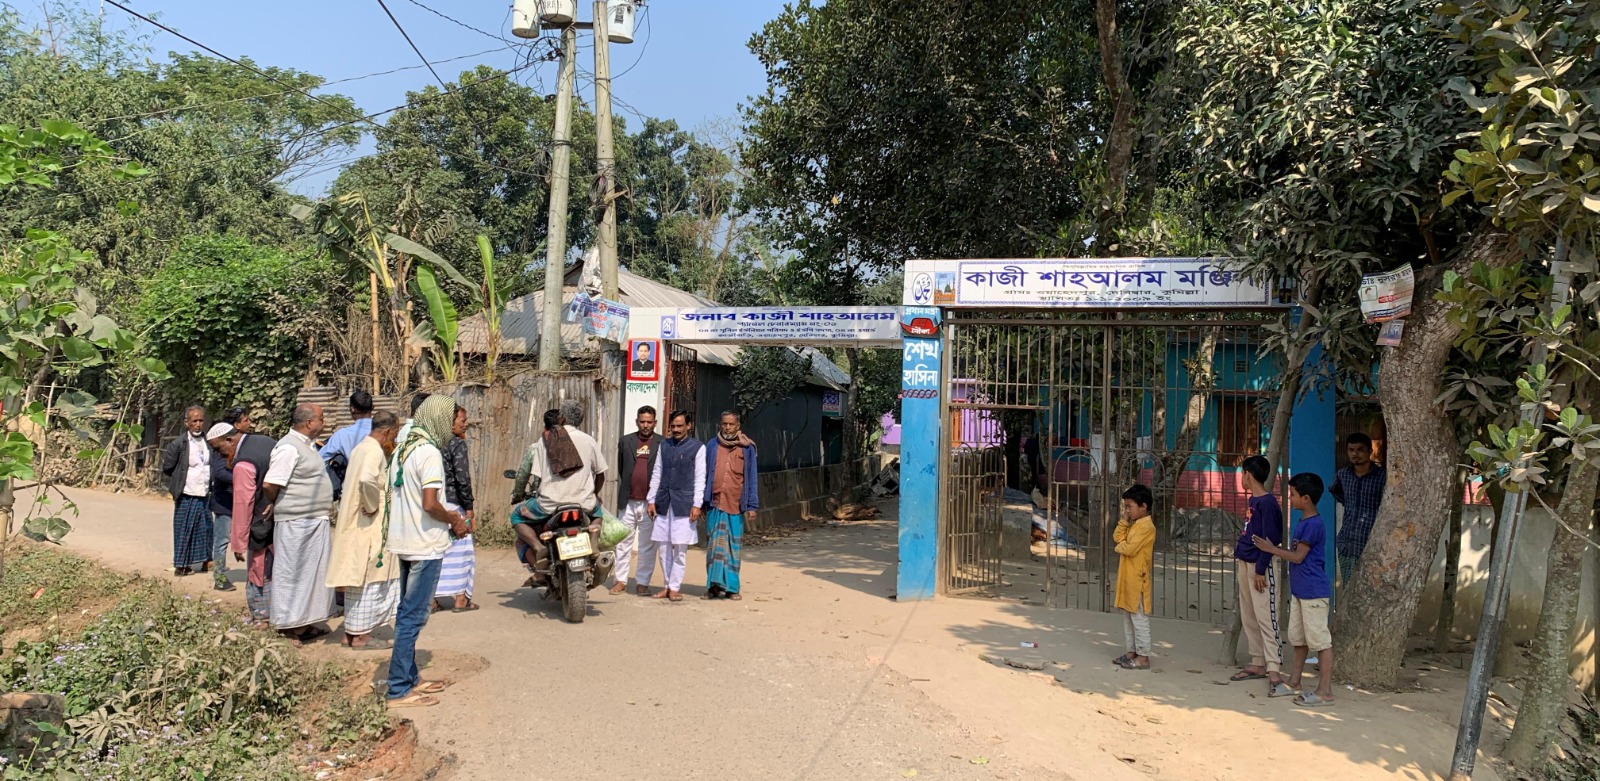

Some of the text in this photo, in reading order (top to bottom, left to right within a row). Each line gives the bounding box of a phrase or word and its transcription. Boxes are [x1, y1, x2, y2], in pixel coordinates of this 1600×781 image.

[963, 265, 1029, 287] কাজী
[1036, 269, 1167, 289] শাহআলম
[681, 310, 896, 322] জনাব কাজী শাহআলম
[911, 326, 930, 335] নৌকা
[904, 340, 939, 361] শেখ
[903, 364, 938, 387] হাসিনা
[626, 382, 658, 393] বাংলাদেশ
